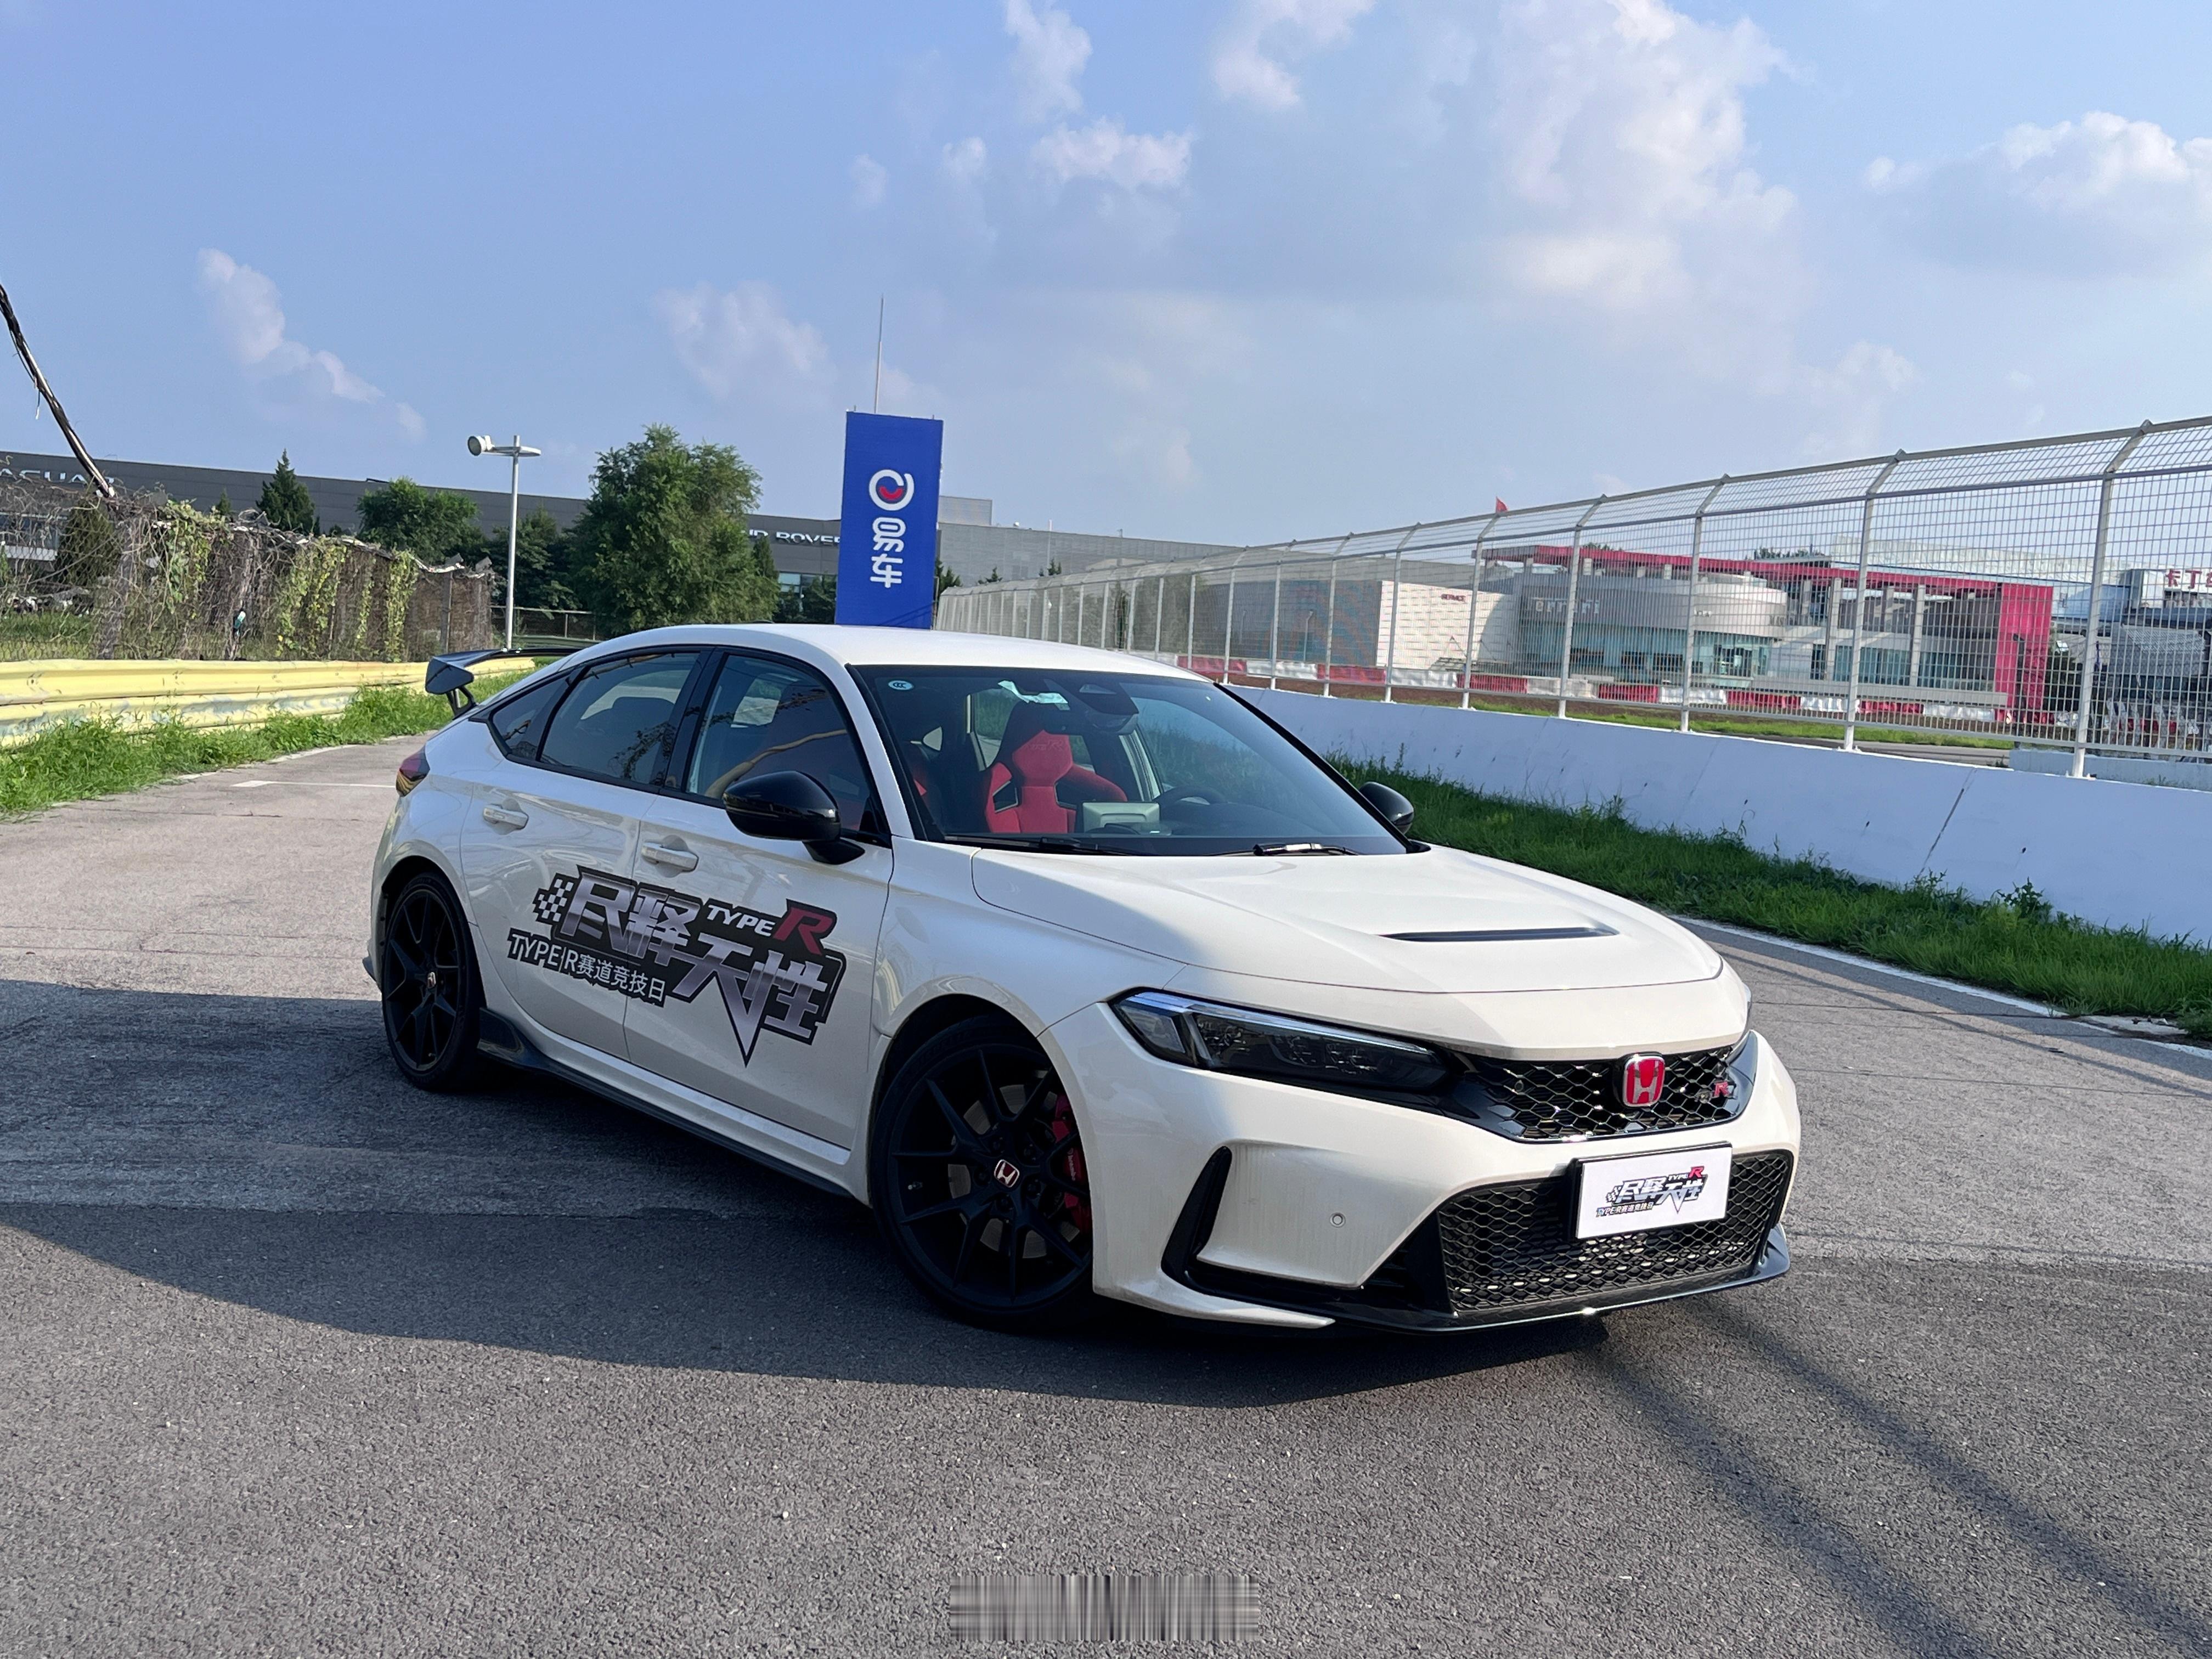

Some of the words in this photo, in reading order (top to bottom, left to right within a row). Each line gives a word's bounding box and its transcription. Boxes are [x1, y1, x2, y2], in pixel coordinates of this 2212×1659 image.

[870, 517, 906, 588] 易车
[511, 934, 562, 966] TYPE
[707, 905, 775, 936] TYPE
[772, 906, 833, 956] R
[1688, 1166, 1705, 1178] R
